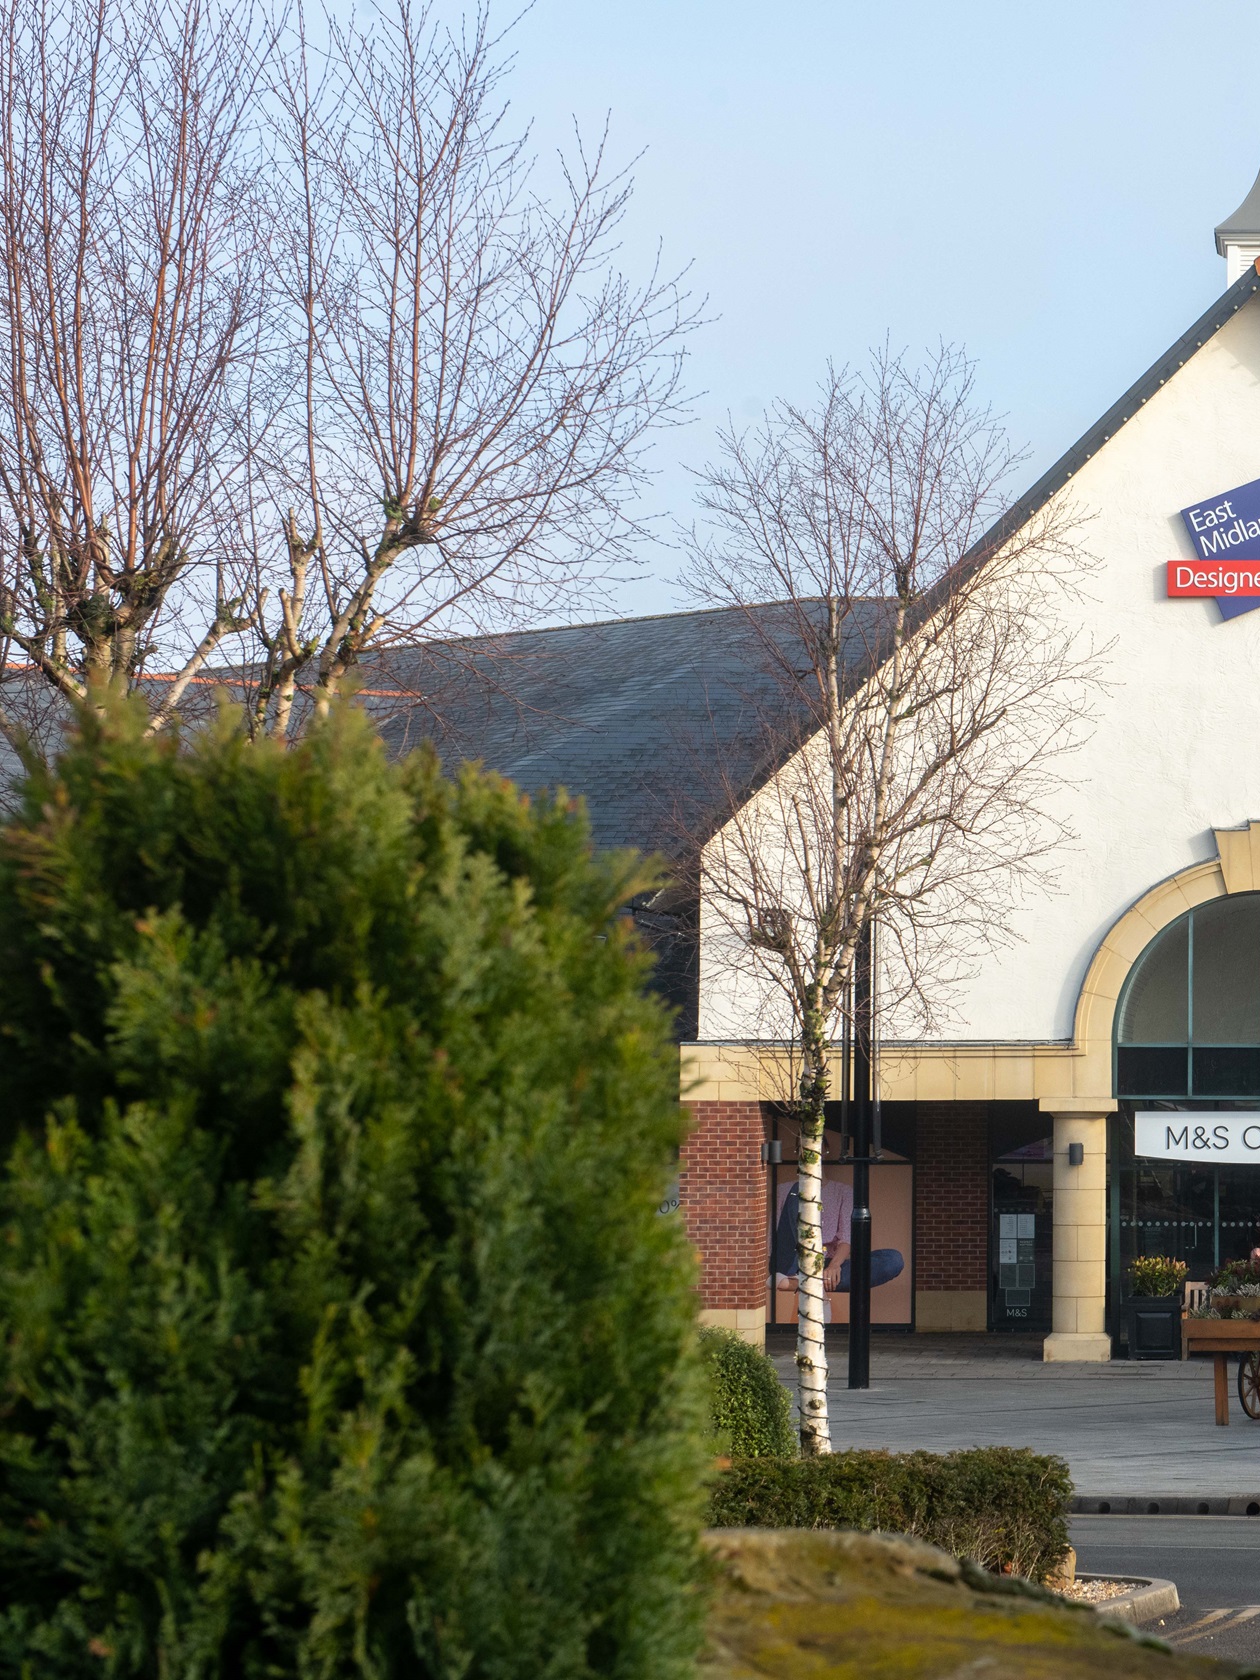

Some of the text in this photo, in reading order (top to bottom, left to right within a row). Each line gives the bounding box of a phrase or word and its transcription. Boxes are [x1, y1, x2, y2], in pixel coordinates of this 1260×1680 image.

[1189, 500, 1237, 532] East
[1165, 1125, 1230, 1150] M&S
[1006, 1308, 1028, 1317] M&S
